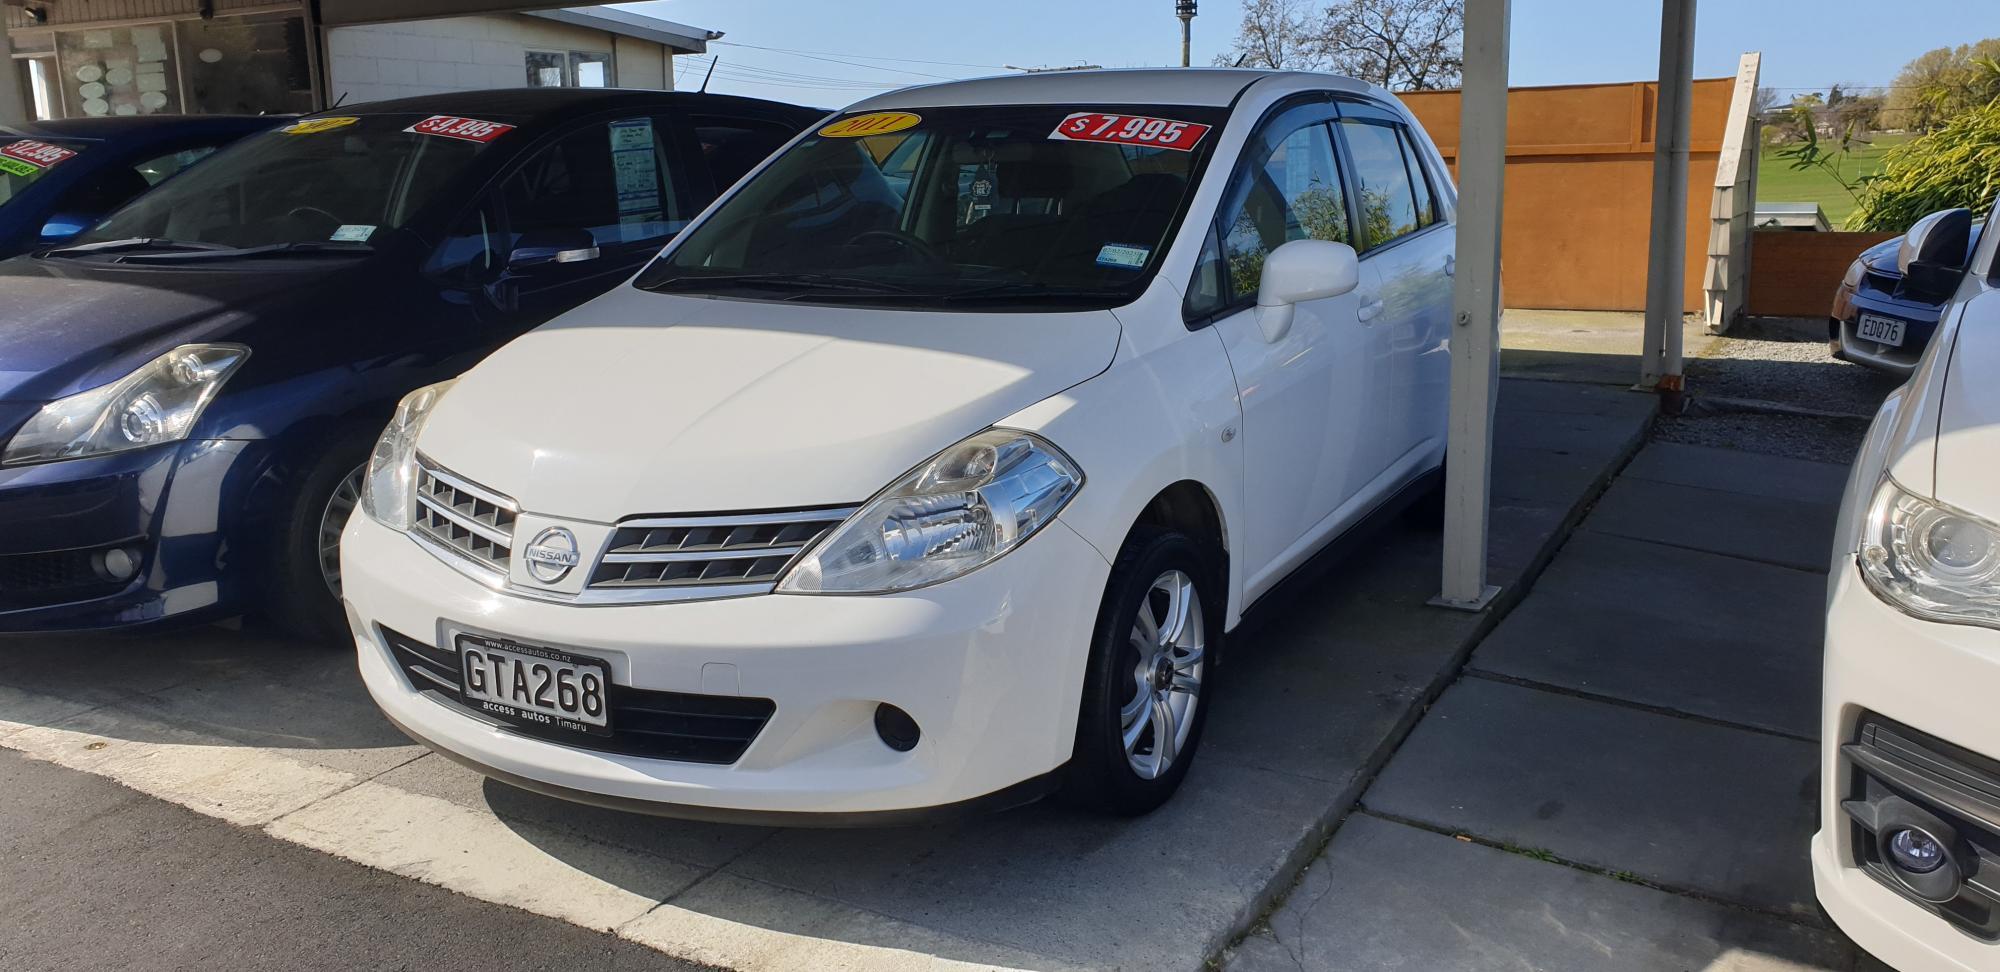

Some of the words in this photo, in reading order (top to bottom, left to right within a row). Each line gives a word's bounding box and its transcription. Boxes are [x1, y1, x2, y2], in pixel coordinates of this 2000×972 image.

[421, 118, 503, 138] $9,995
[6, 141, 71, 163] $12,995
[1862, 318, 1899, 342] EDQ76
[528, 548, 572, 563] NISSAN
[484, 639, 572, 663] www.accessautos.co.nz
[464, 648, 603, 718] GTA268
[482, 701, 516, 716] access
[521, 709, 551, 724] autos
[554, 716, 587, 732] Timaru
